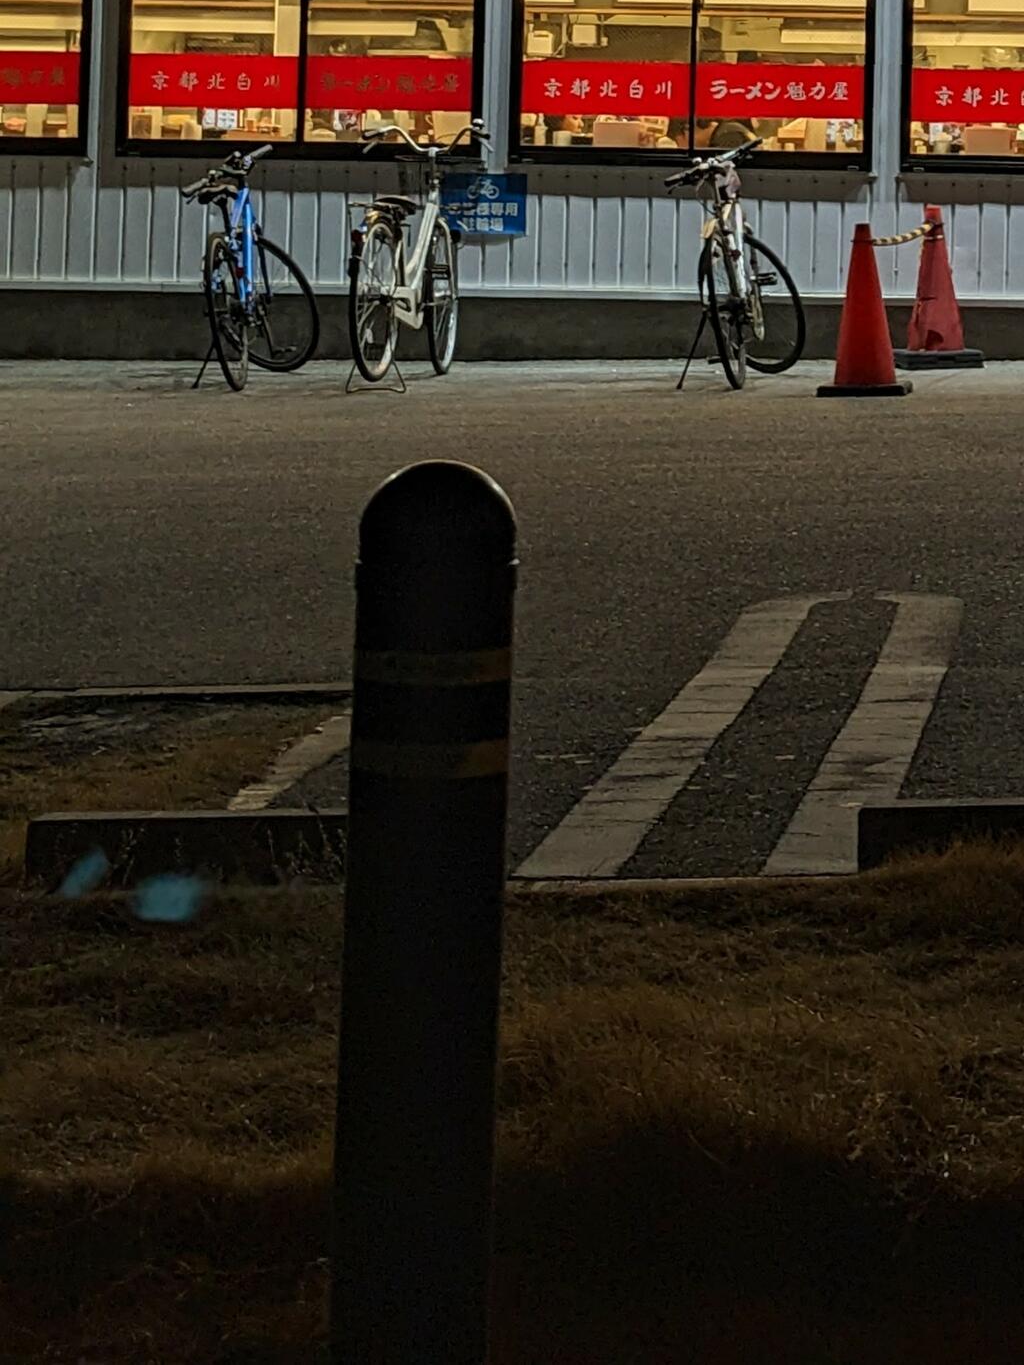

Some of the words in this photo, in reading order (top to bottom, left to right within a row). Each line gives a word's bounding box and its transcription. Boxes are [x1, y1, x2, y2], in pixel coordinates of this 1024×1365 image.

[151, 70, 281, 91] 京都北白川
[542, 77, 672, 99] 京都北白川
[709, 78, 850, 102] ラーメン魁力屋
